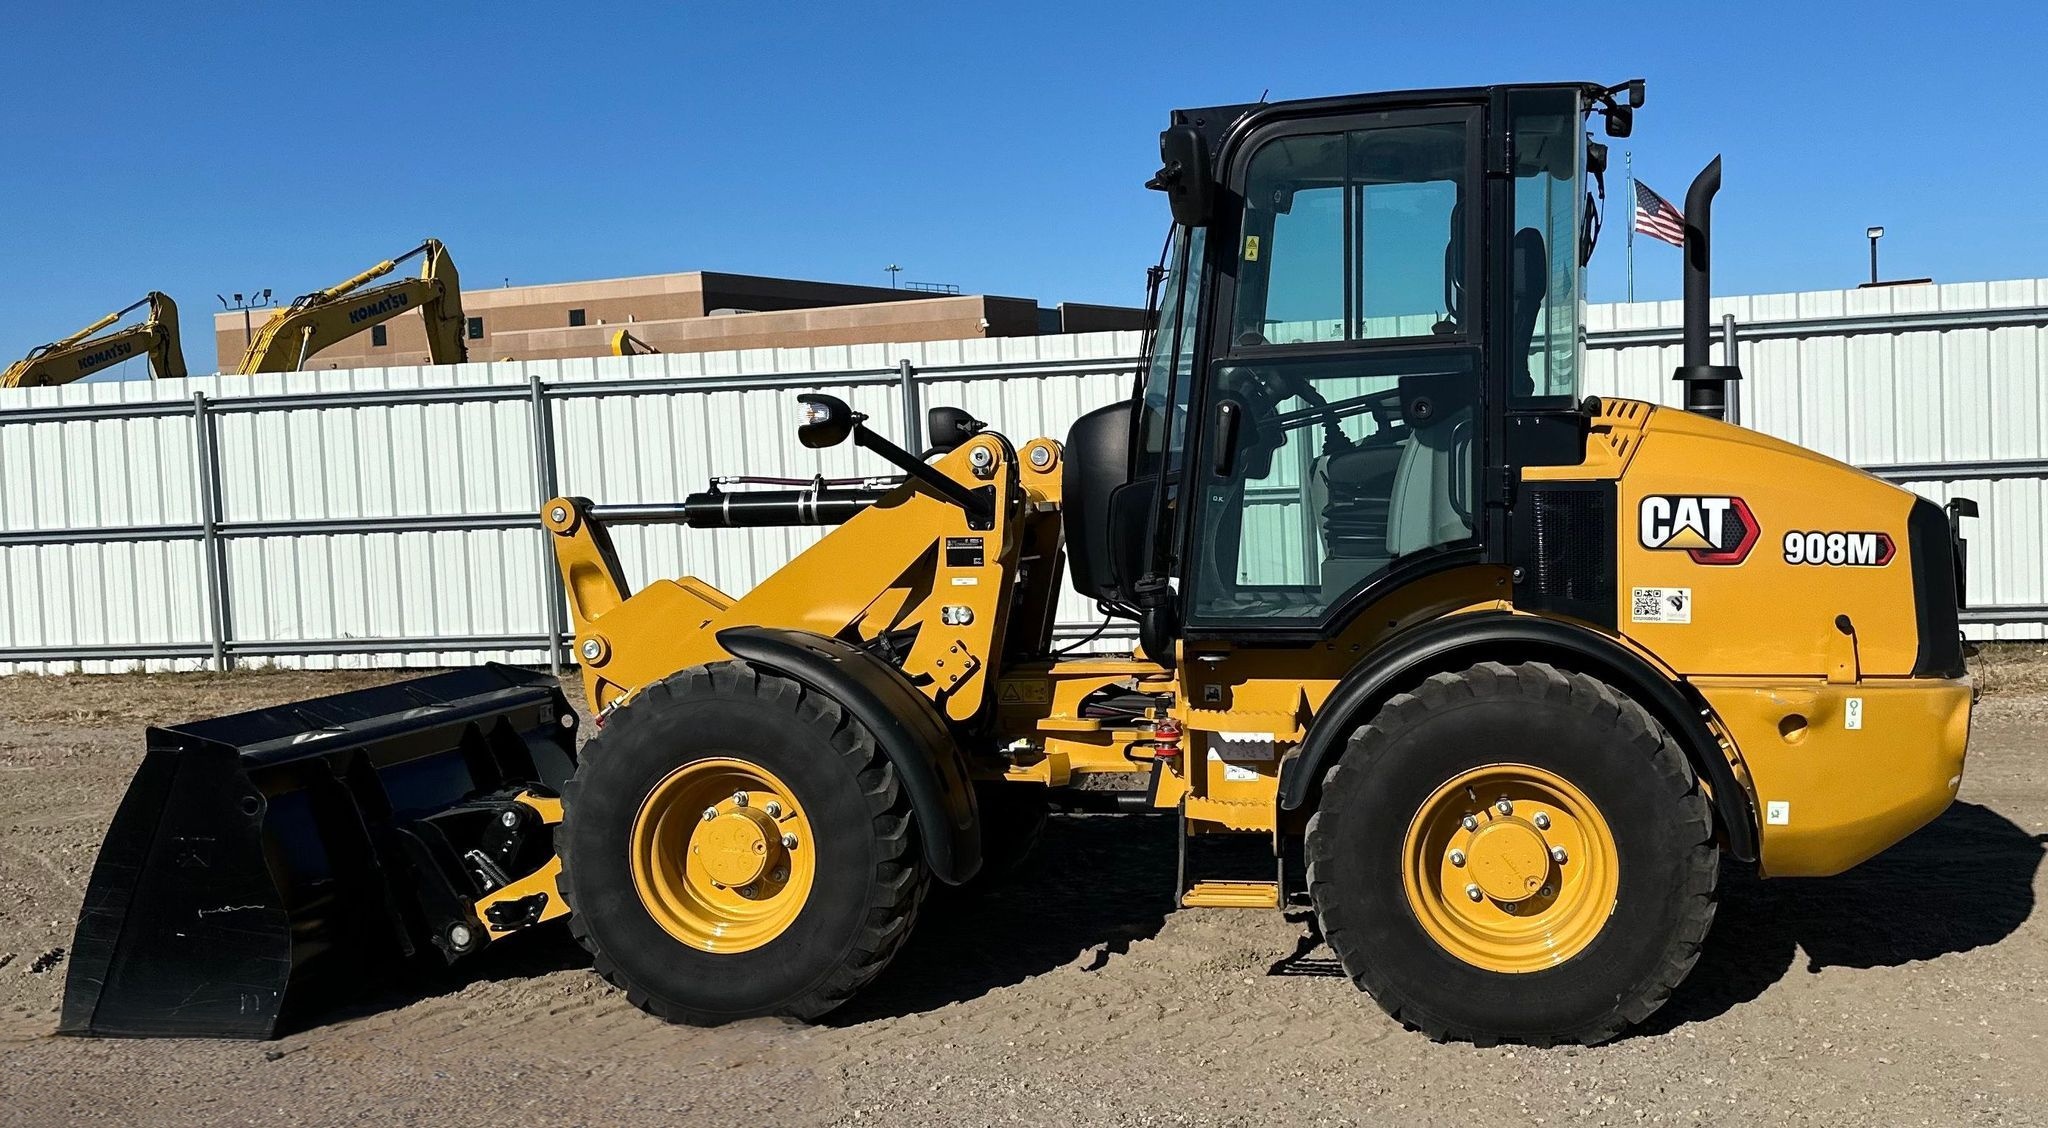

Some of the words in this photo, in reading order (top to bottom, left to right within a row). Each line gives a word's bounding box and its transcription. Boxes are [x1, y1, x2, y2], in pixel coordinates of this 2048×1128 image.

[349, 293, 408, 323] KOMATSU
[78, 342, 131, 369] KOMATSU
[1641, 496, 1731, 549] CAT
[1785, 532, 1877, 565] 908M
